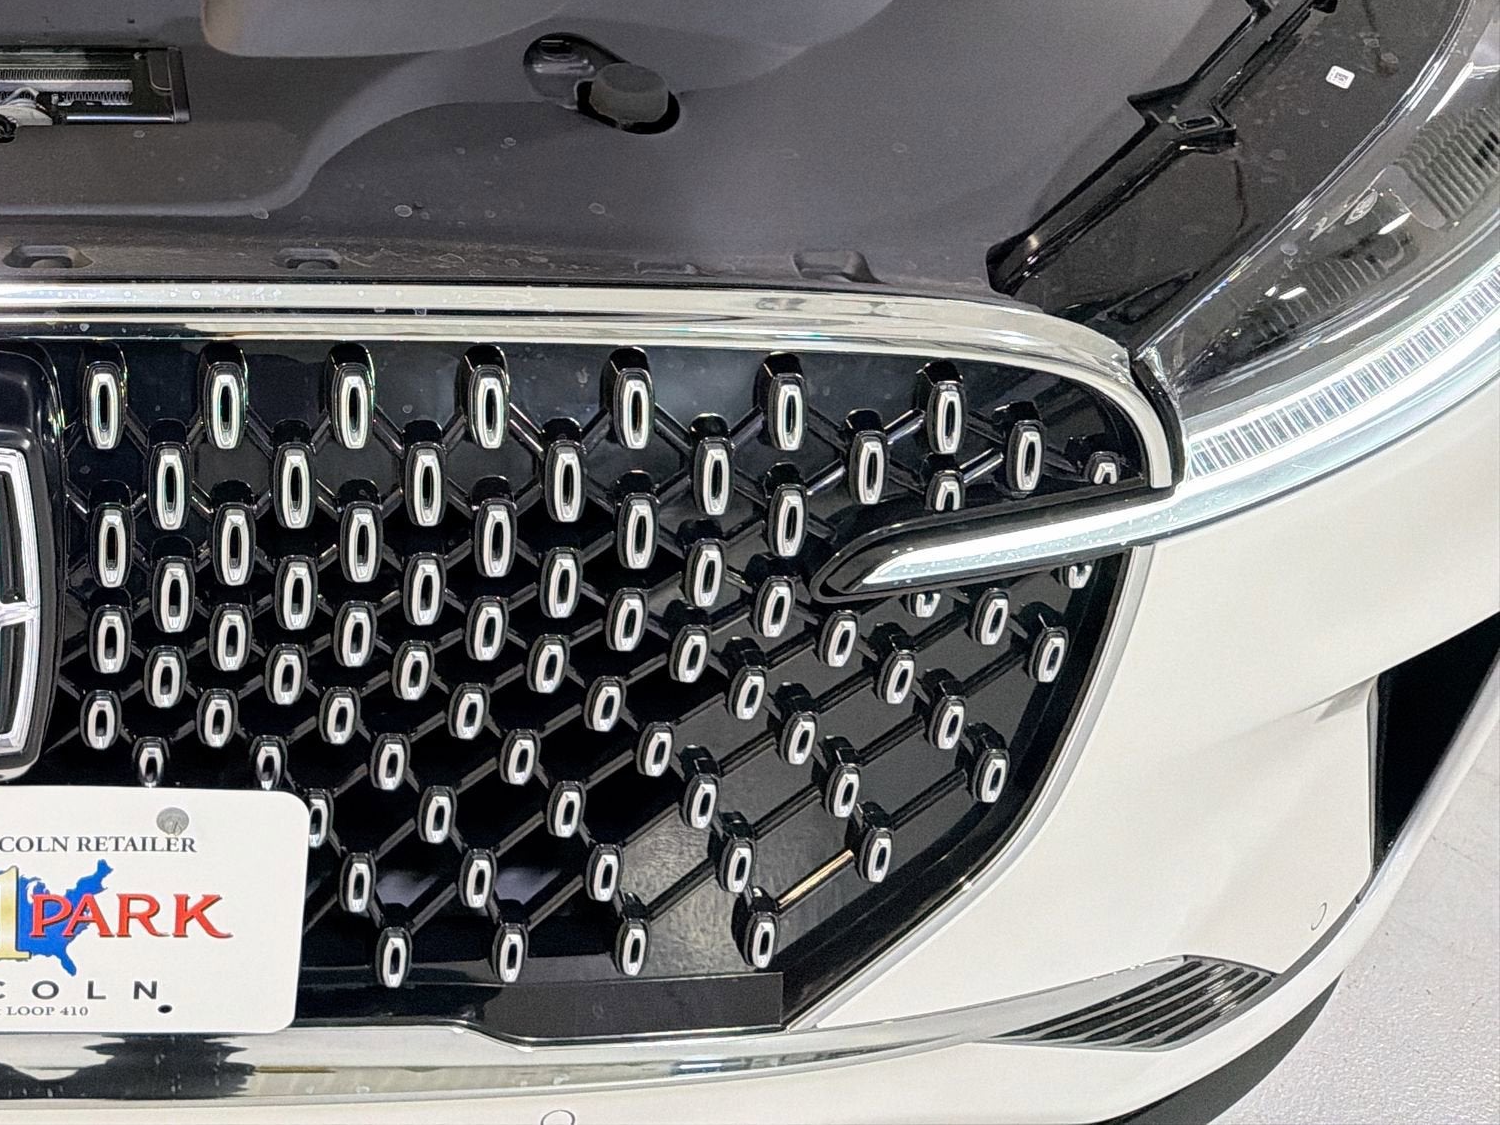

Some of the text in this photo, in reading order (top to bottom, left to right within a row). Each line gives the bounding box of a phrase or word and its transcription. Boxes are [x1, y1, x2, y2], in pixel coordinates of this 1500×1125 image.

[76, 836, 198, 853] RETAILER
[29, 893, 234, 940] PARK
[6, 1005, 56, 1017] LOOP
[59, 1005, 89, 1017] 410
